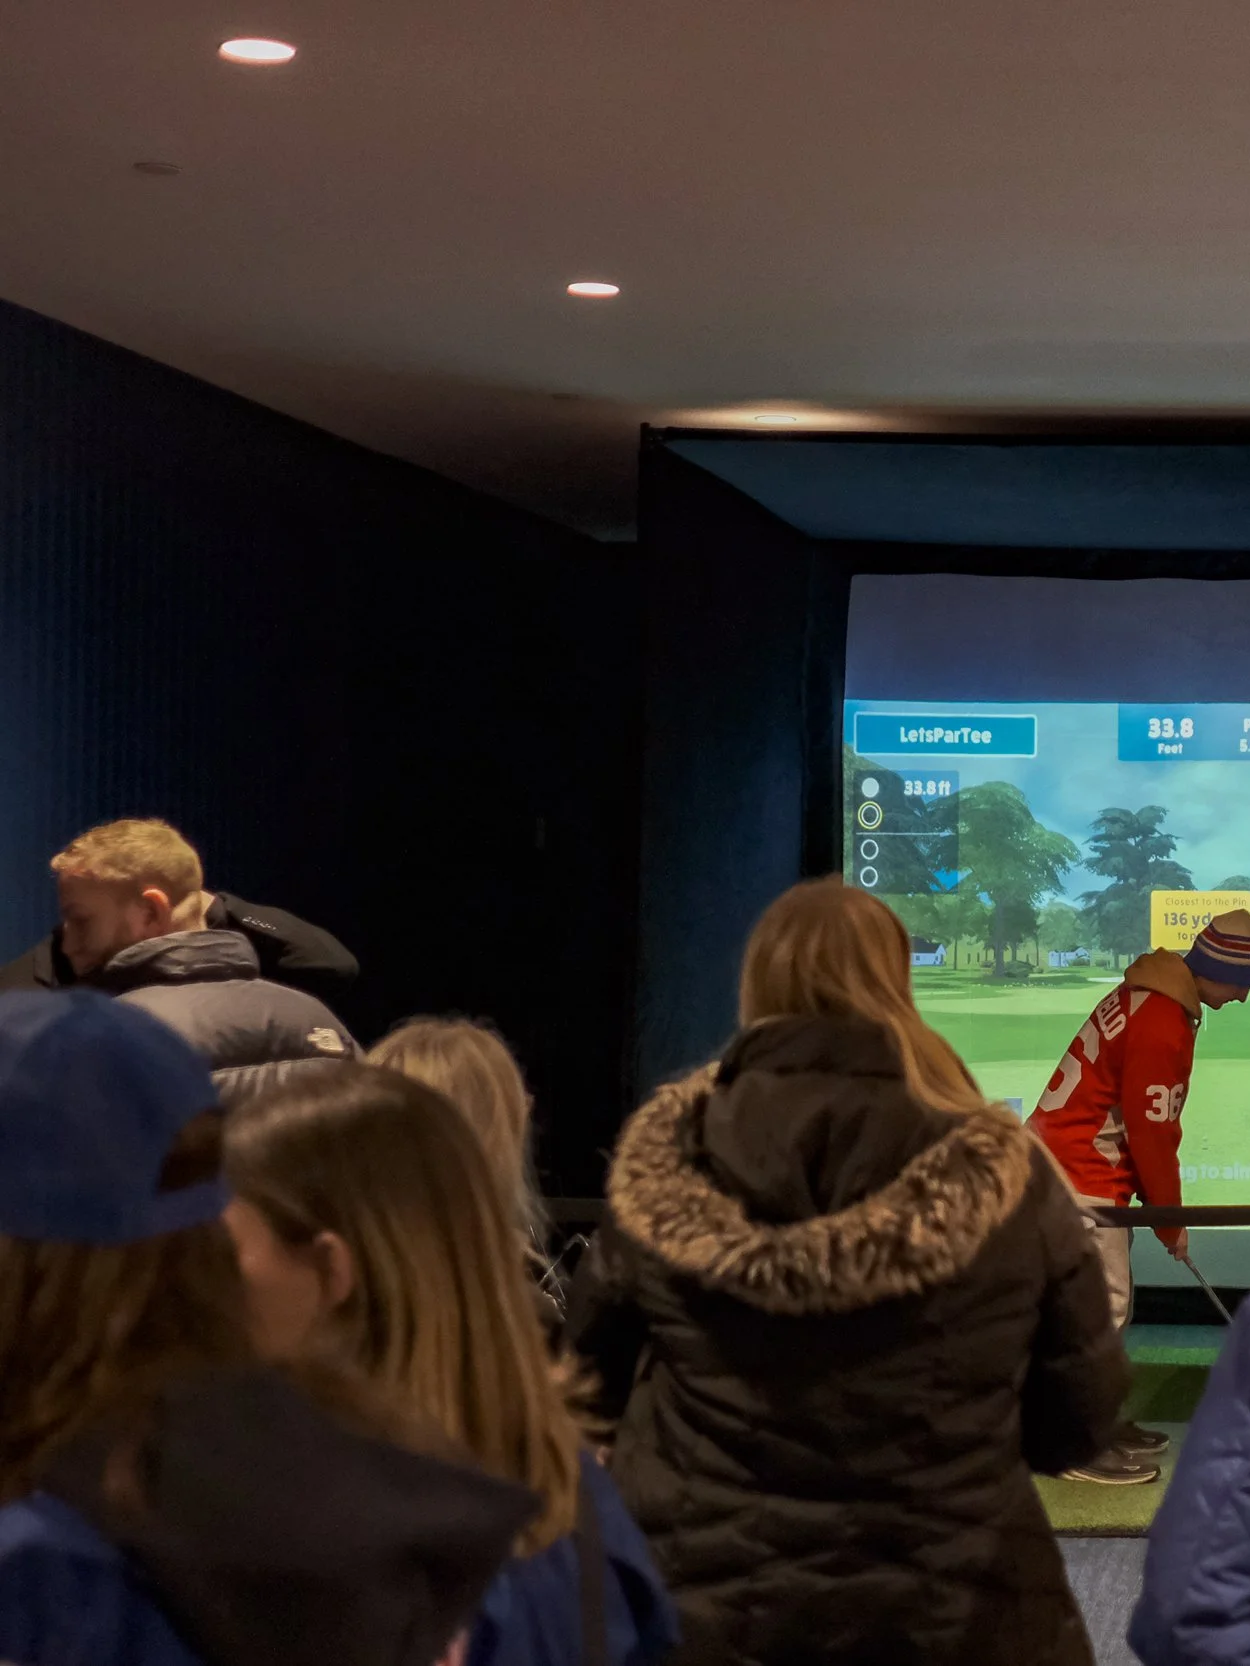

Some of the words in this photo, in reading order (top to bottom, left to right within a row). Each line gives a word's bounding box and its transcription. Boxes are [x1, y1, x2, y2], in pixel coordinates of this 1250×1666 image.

[1148, 717, 1194, 738] 33.8
[900, 727, 992, 744] LetsParTee
[1157, 743, 1184, 754] Feet
[903, 780, 936, 795] 33.8
[938, 780, 951, 795] ft
[1165, 898, 1199, 906] Closest
[1202, 898, 1212, 906] to
[1214, 898, 1230, 906] the
[1232, 897, 1247, 906] Pin
[1164, 912, 1188, 926] 136
[1145, 1083, 1184, 1123] 36
